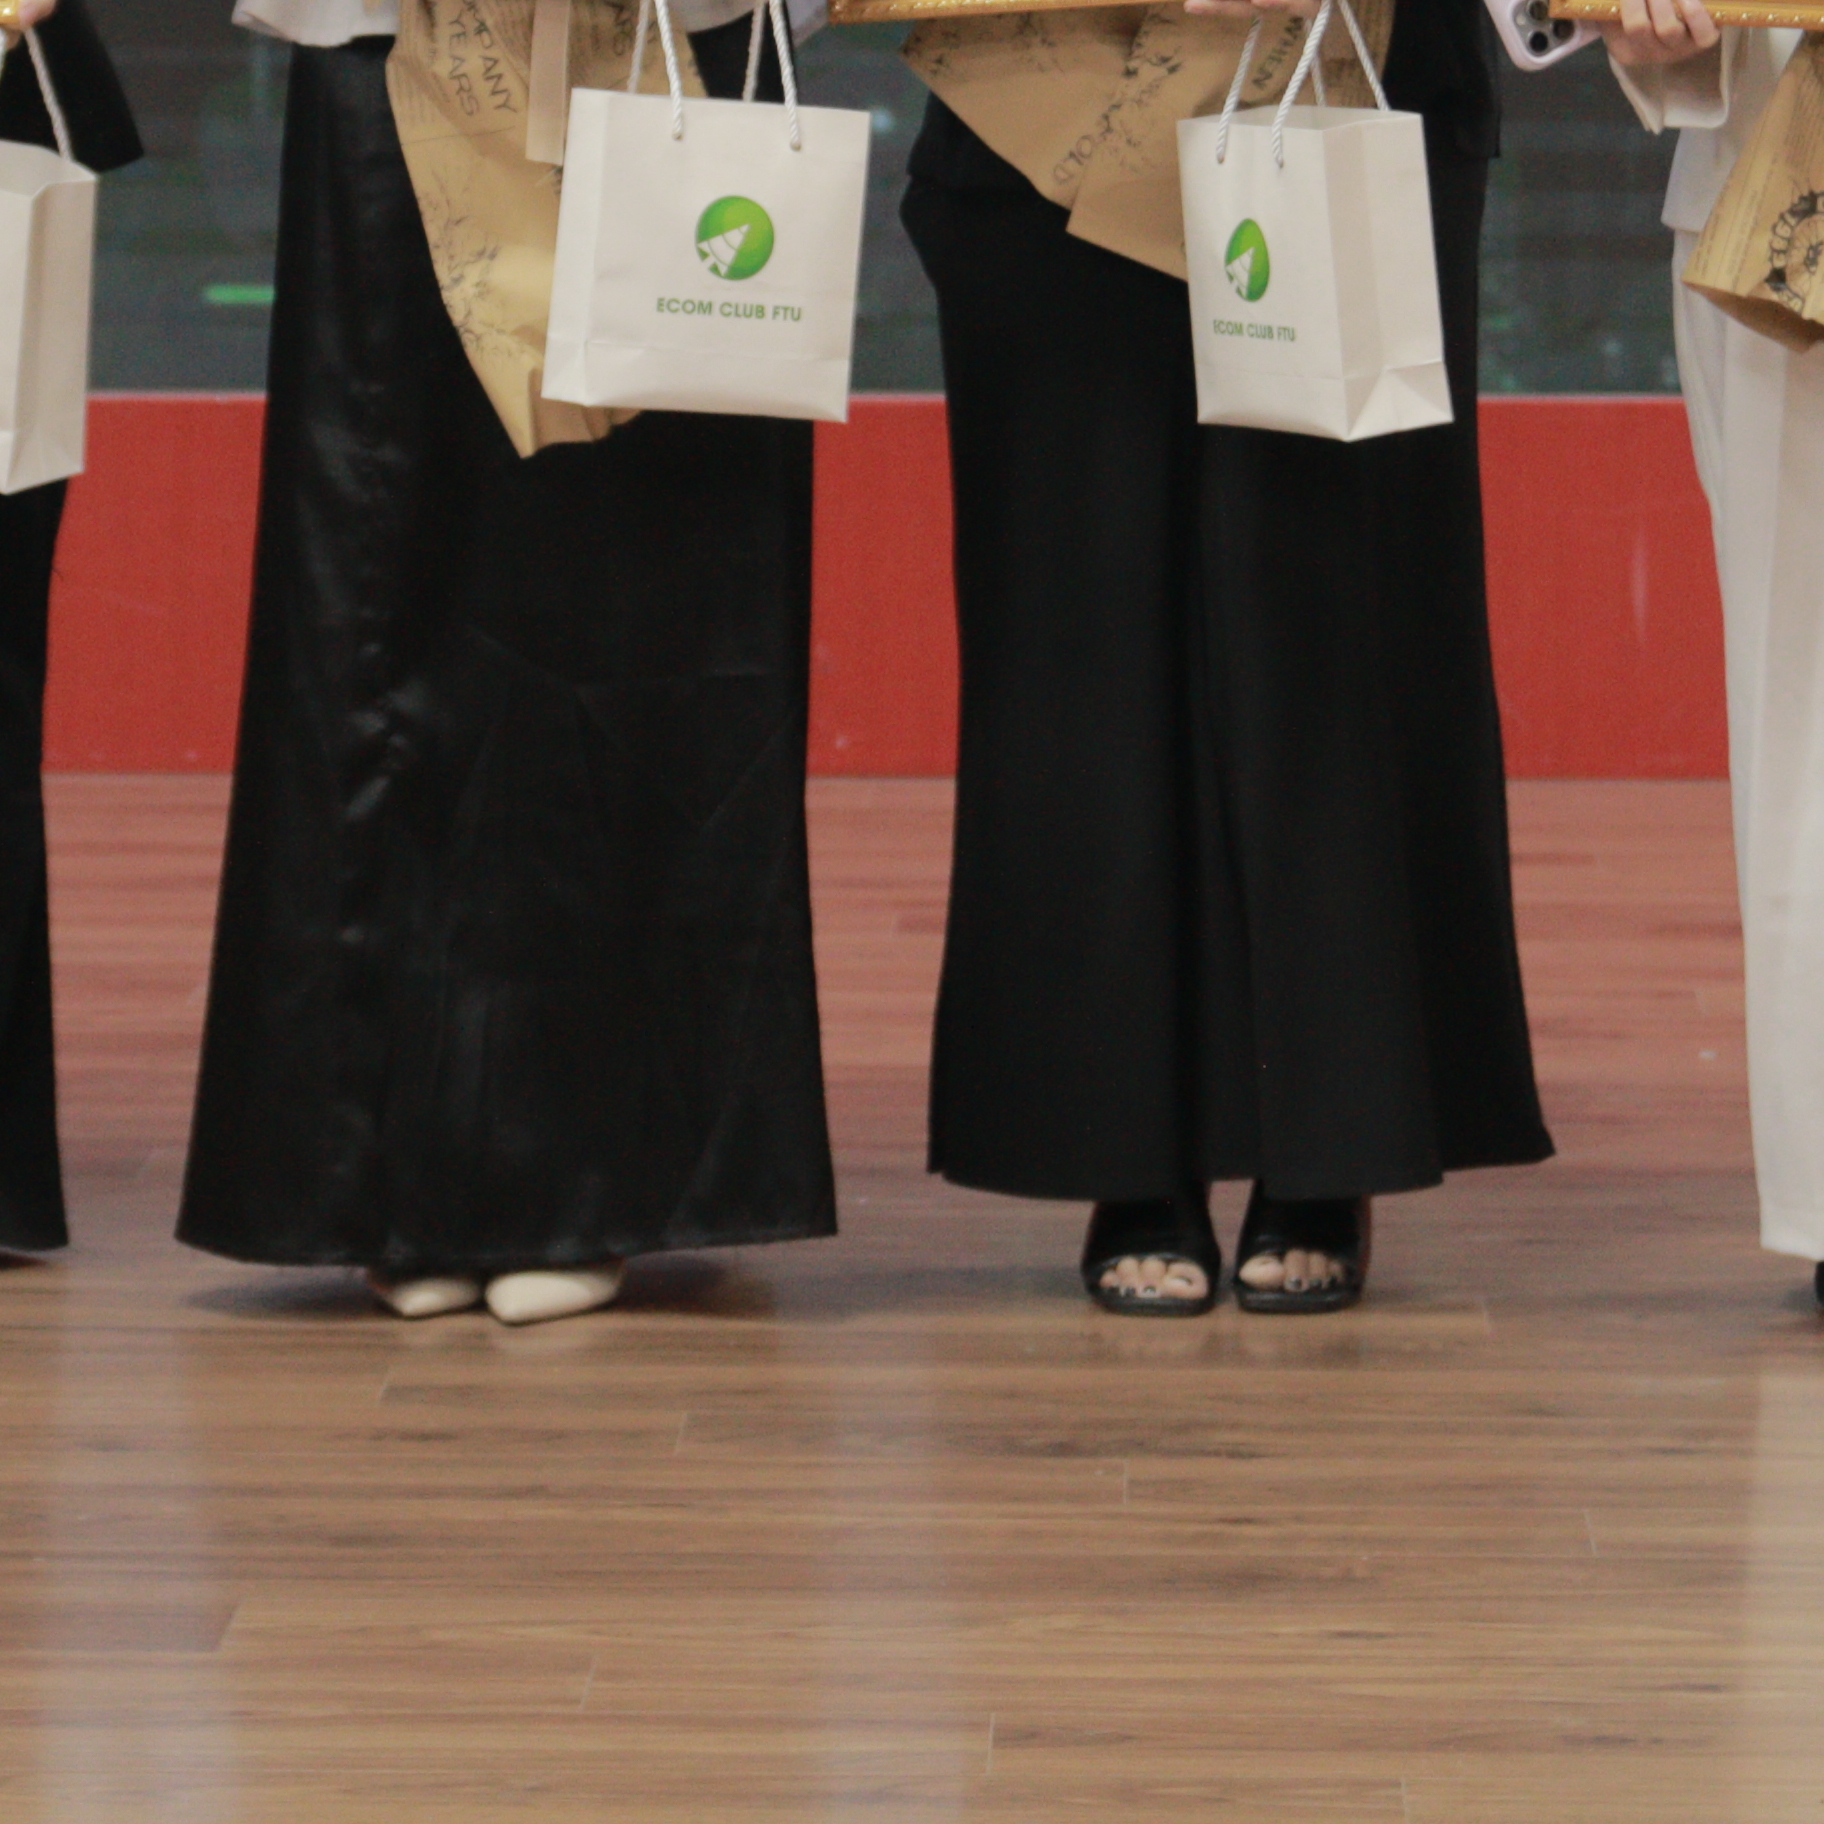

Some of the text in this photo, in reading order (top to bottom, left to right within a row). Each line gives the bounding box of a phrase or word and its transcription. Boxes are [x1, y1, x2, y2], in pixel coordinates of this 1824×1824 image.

[656, 297, 803, 323] ECOM CLUB FTU
[1213, 319, 1296, 343] ECOM CLUB FTU
